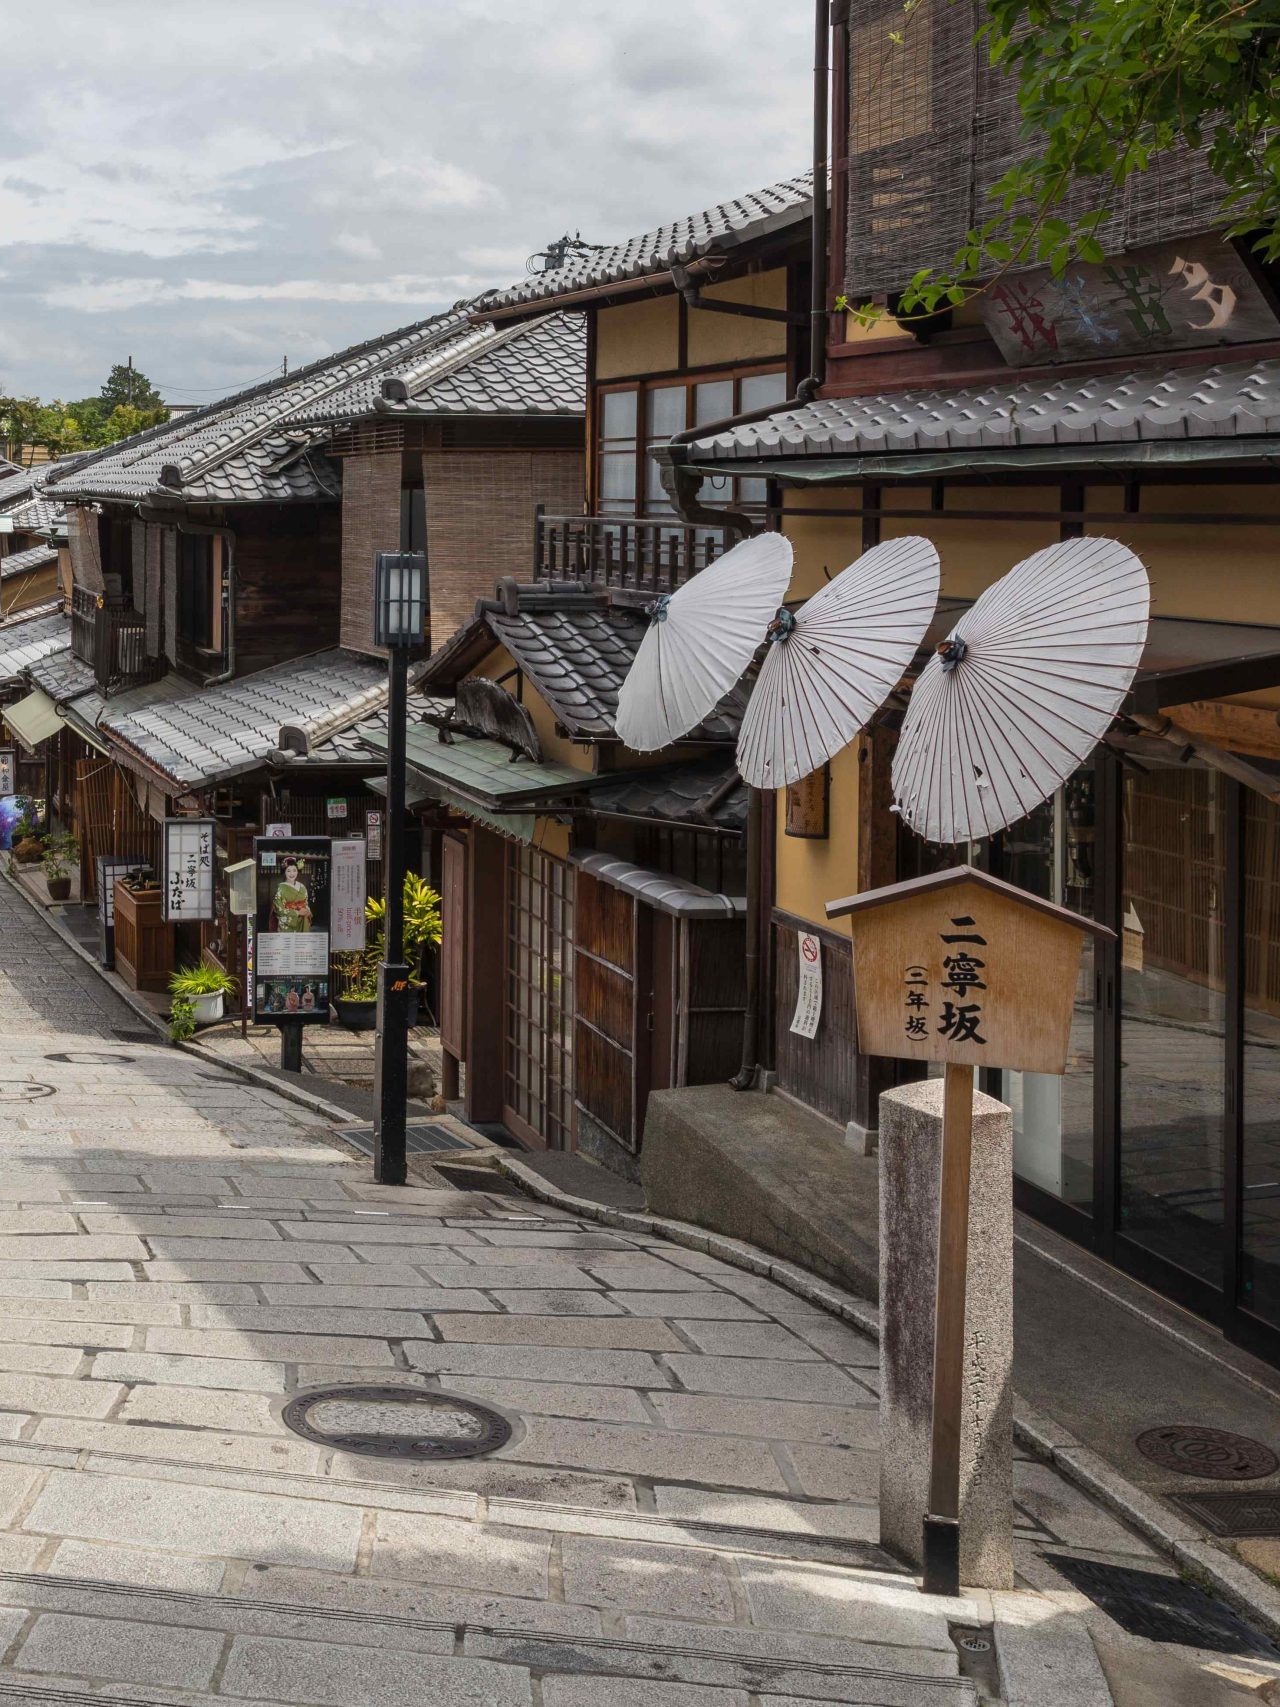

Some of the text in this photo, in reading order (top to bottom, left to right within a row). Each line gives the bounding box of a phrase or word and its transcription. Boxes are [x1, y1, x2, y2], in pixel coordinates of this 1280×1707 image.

[199, 832, 210, 867] そば処
[185, 854, 198, 889] 二寧坂
[170, 871, 186, 911] ふたば
[937, 916, 988, 1044] 二寧坂
